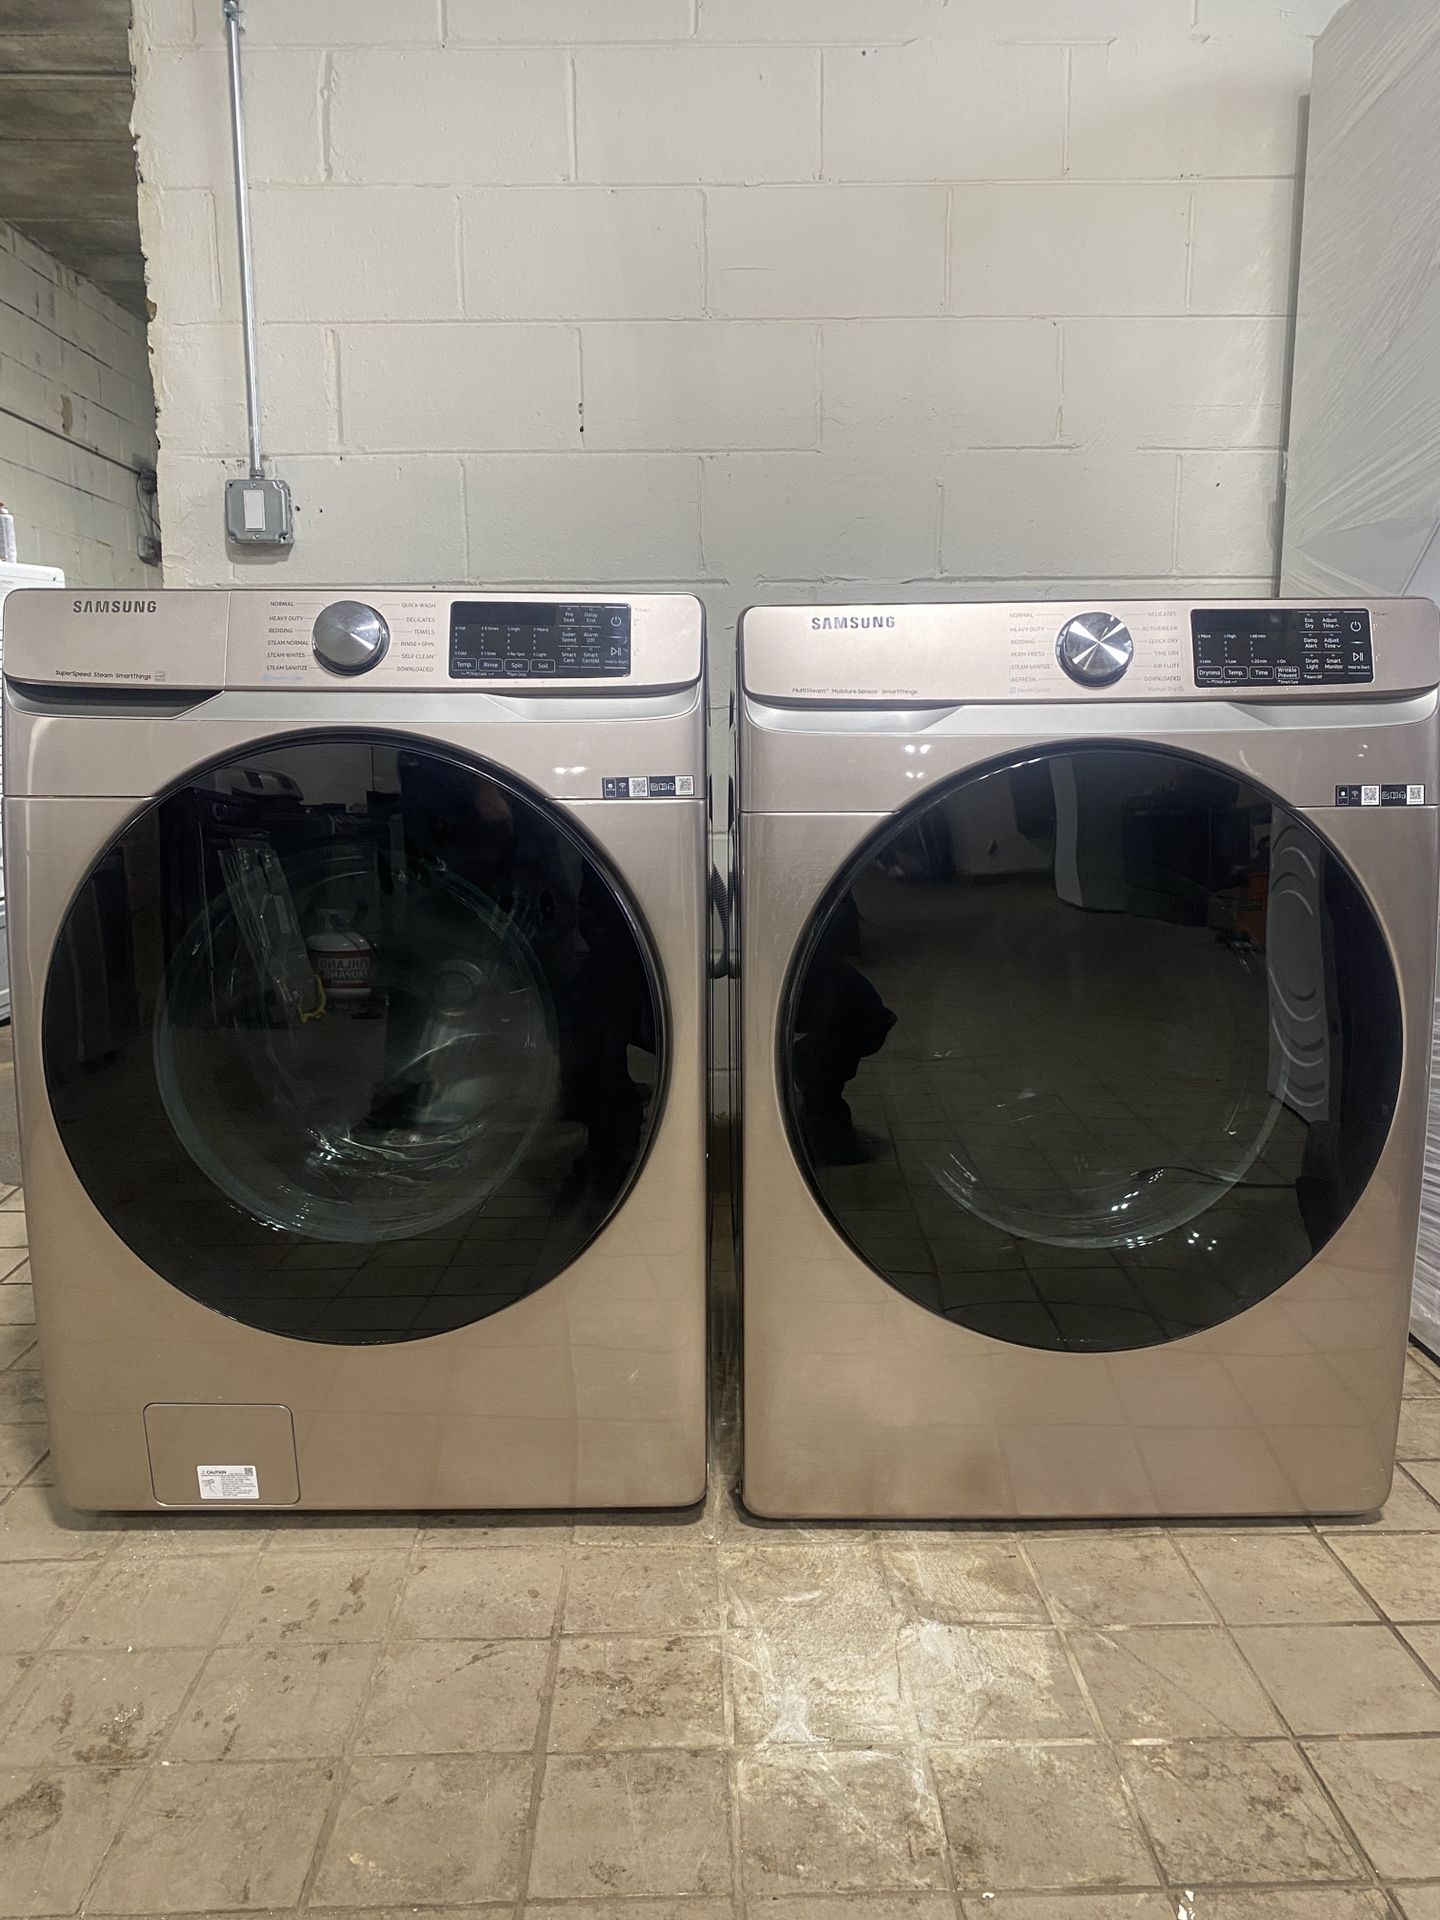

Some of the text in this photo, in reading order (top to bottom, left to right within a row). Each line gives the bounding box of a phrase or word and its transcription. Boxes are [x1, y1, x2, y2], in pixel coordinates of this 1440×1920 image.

[73, 600, 157, 613] SAMSUNG
[812, 616, 896, 630] SAMSUNG
[55, 670, 92, 679] SuperSpeed
[116, 672, 152, 681] SmartThings
